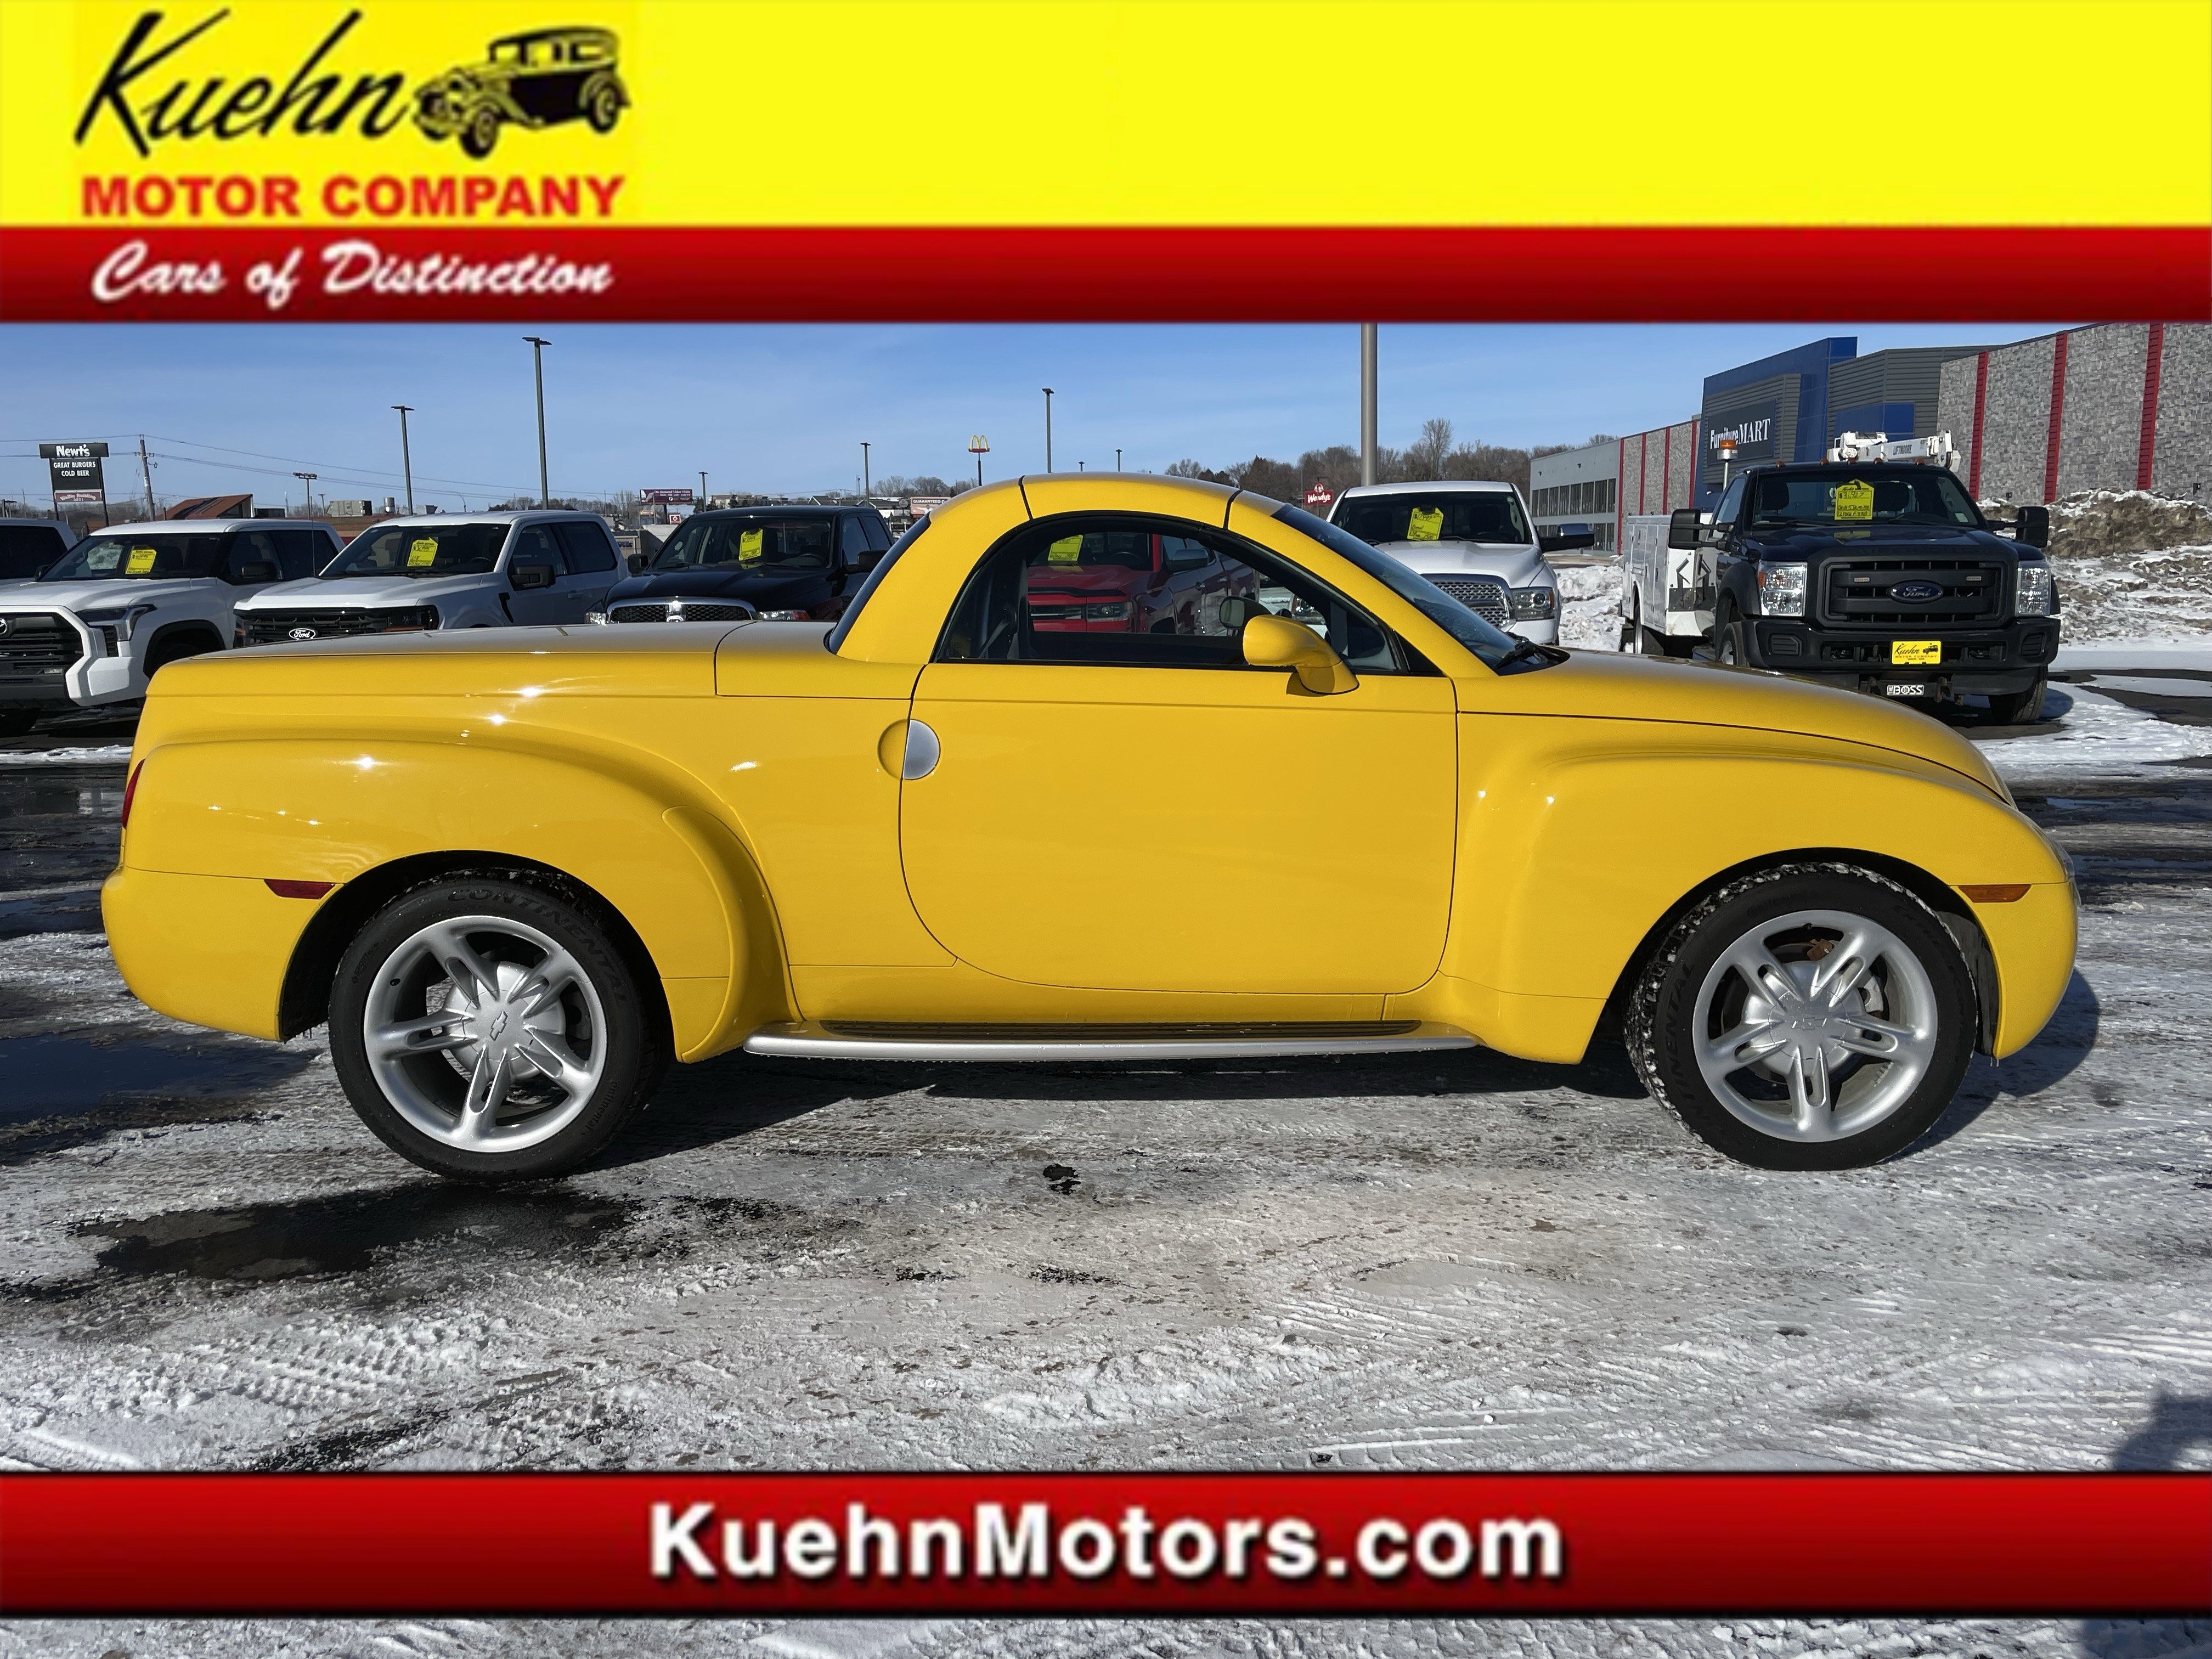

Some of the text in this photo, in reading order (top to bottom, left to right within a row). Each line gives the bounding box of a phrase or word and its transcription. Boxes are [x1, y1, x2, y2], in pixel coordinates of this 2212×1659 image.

[56, 444, 90, 457] Newt's
[1308, 492, 1331, 503] Wendy's
[1903, 585, 1931, 597] Ford
[1894, 644, 1920, 655] Kuehn
[1893, 685, 1923, 695] BOSS
